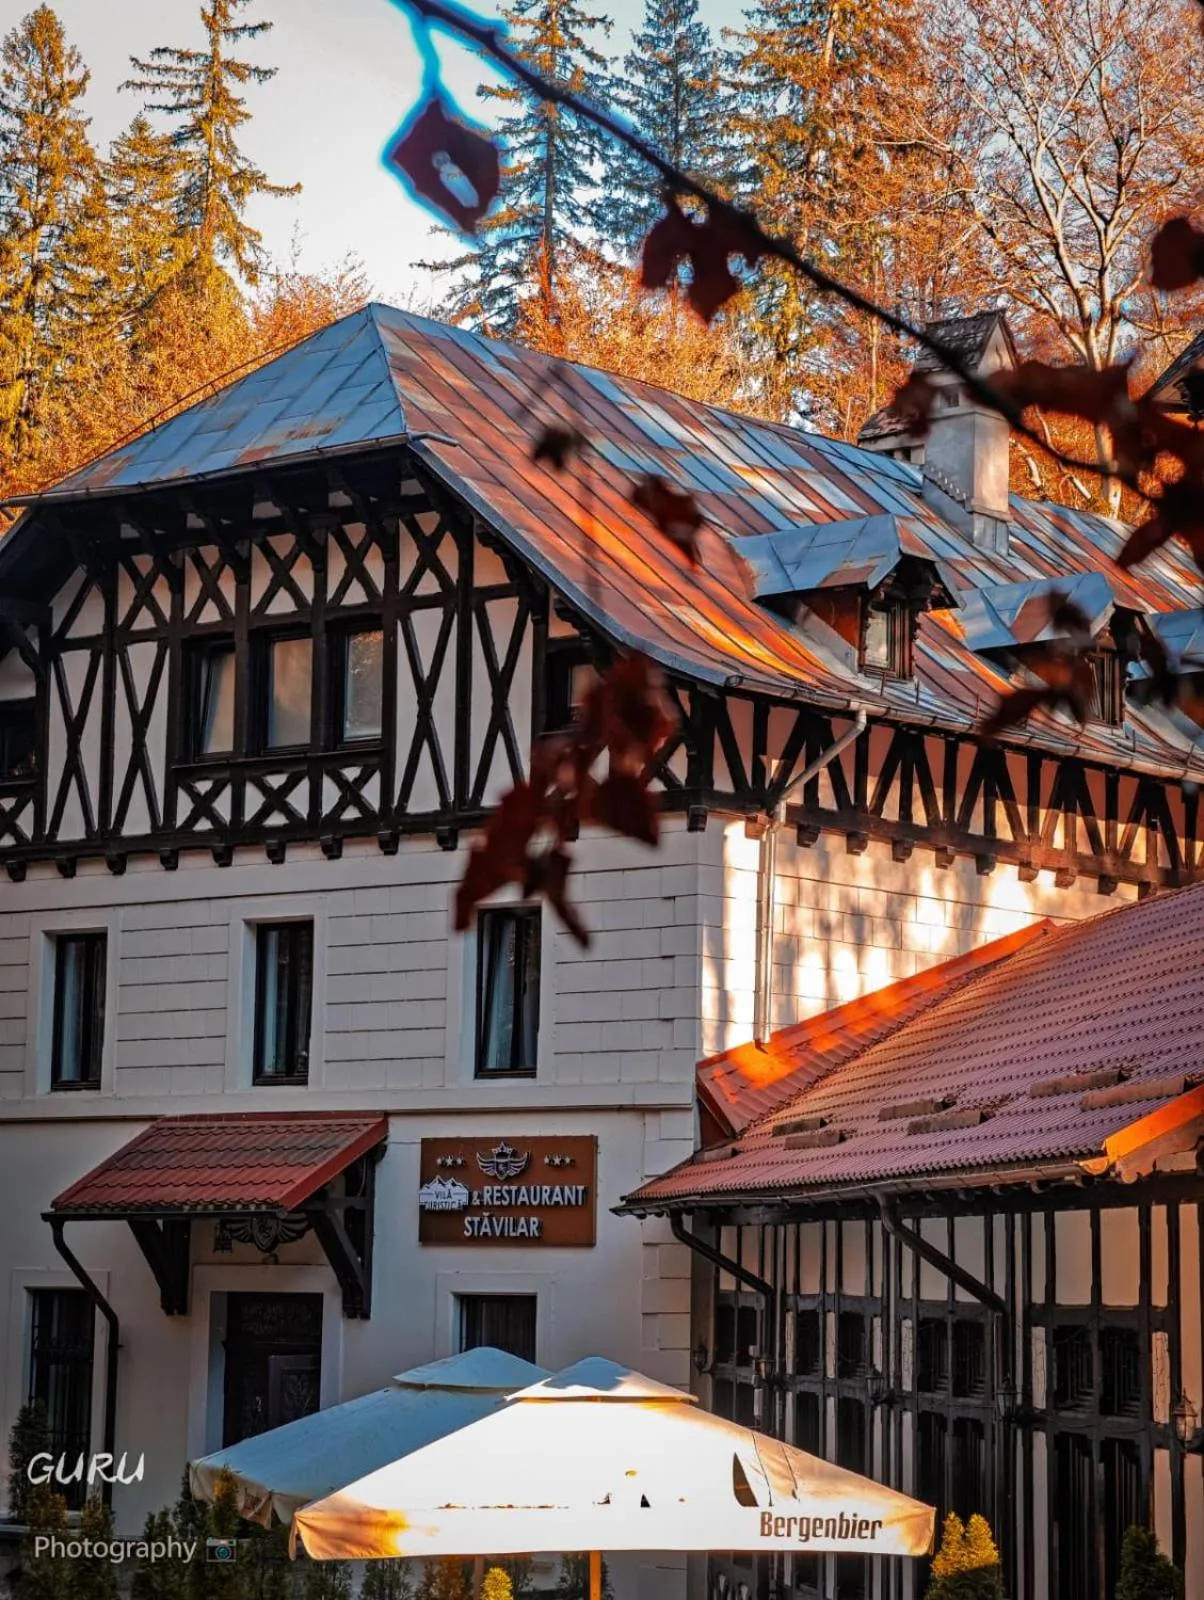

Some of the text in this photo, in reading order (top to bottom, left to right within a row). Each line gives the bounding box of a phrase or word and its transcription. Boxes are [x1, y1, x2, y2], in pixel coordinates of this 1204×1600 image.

[471, 1185, 585, 1206] & RESTAURANT
[463, 1212, 539, 1237] STĂVILAR
[760, 1511, 882, 1542] Bergenbier
